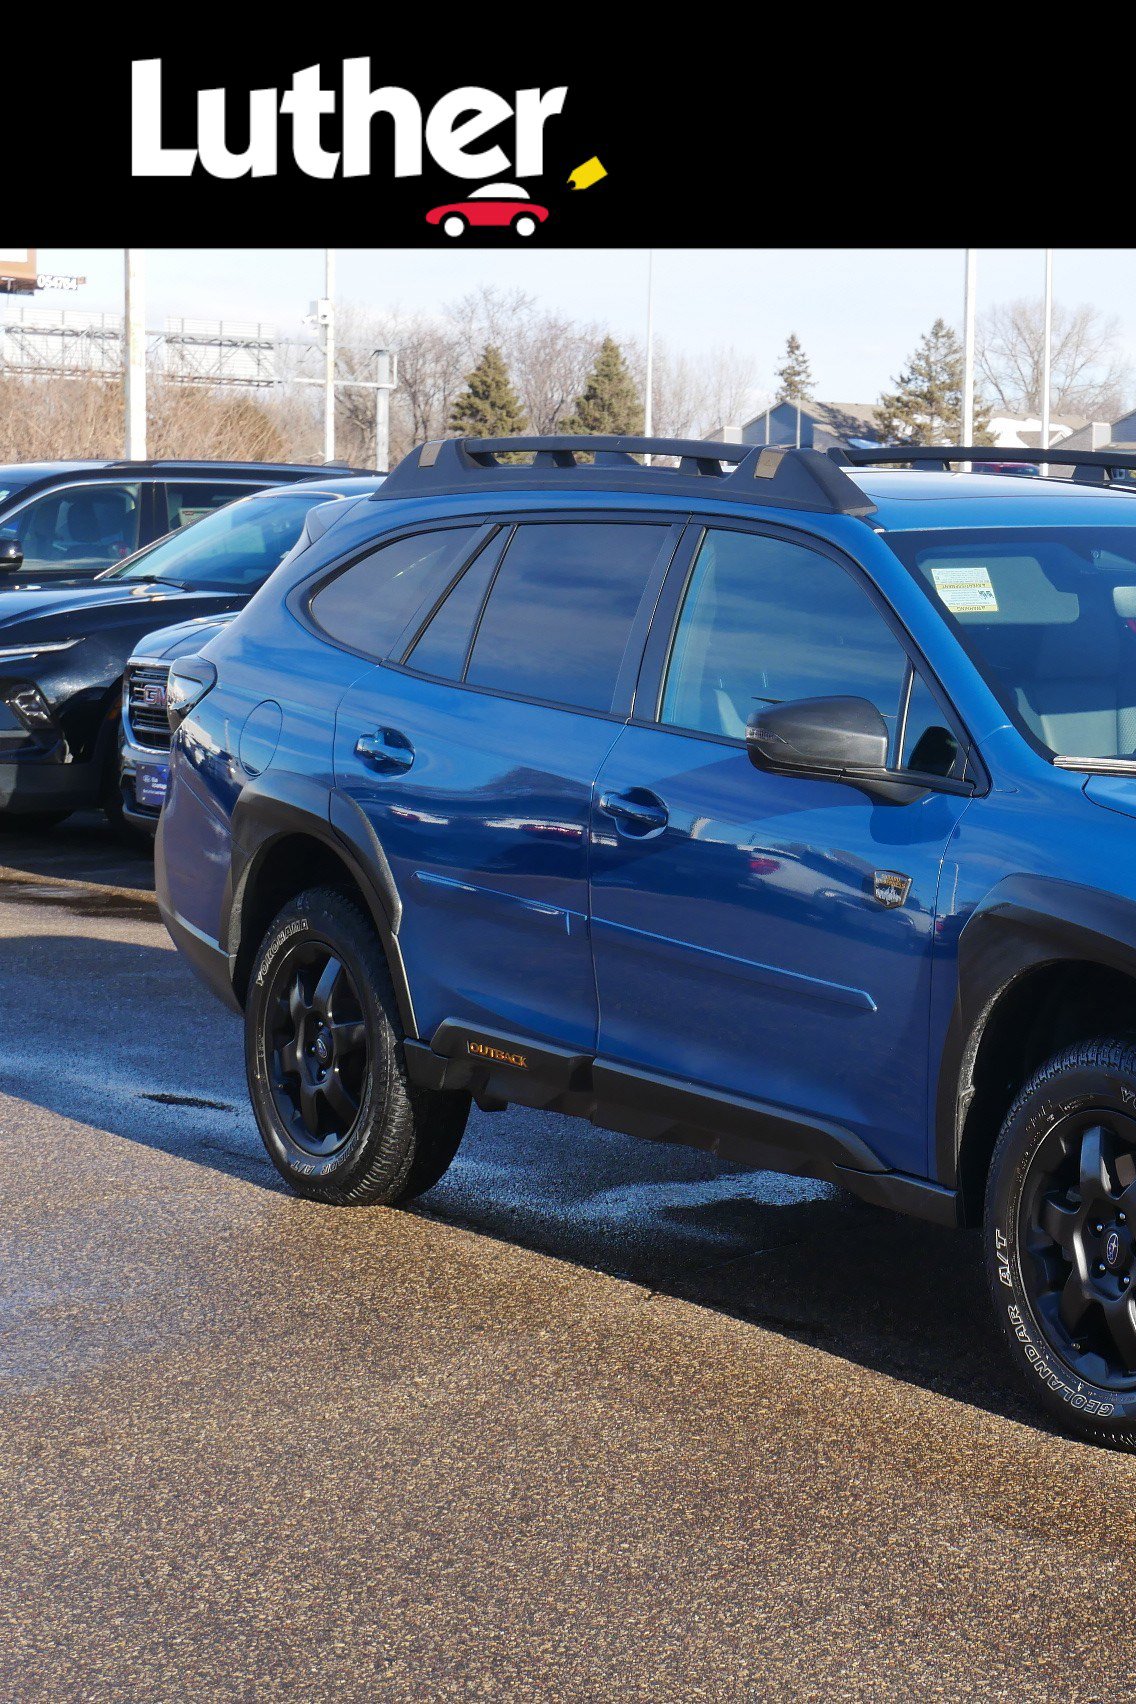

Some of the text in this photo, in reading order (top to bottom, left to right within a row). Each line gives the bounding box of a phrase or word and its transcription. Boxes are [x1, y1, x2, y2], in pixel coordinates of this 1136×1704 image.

[469, 1042, 529, 1068] OUTBACK
[995, 1228, 1115, 1418] GEOLANDAR A/T
